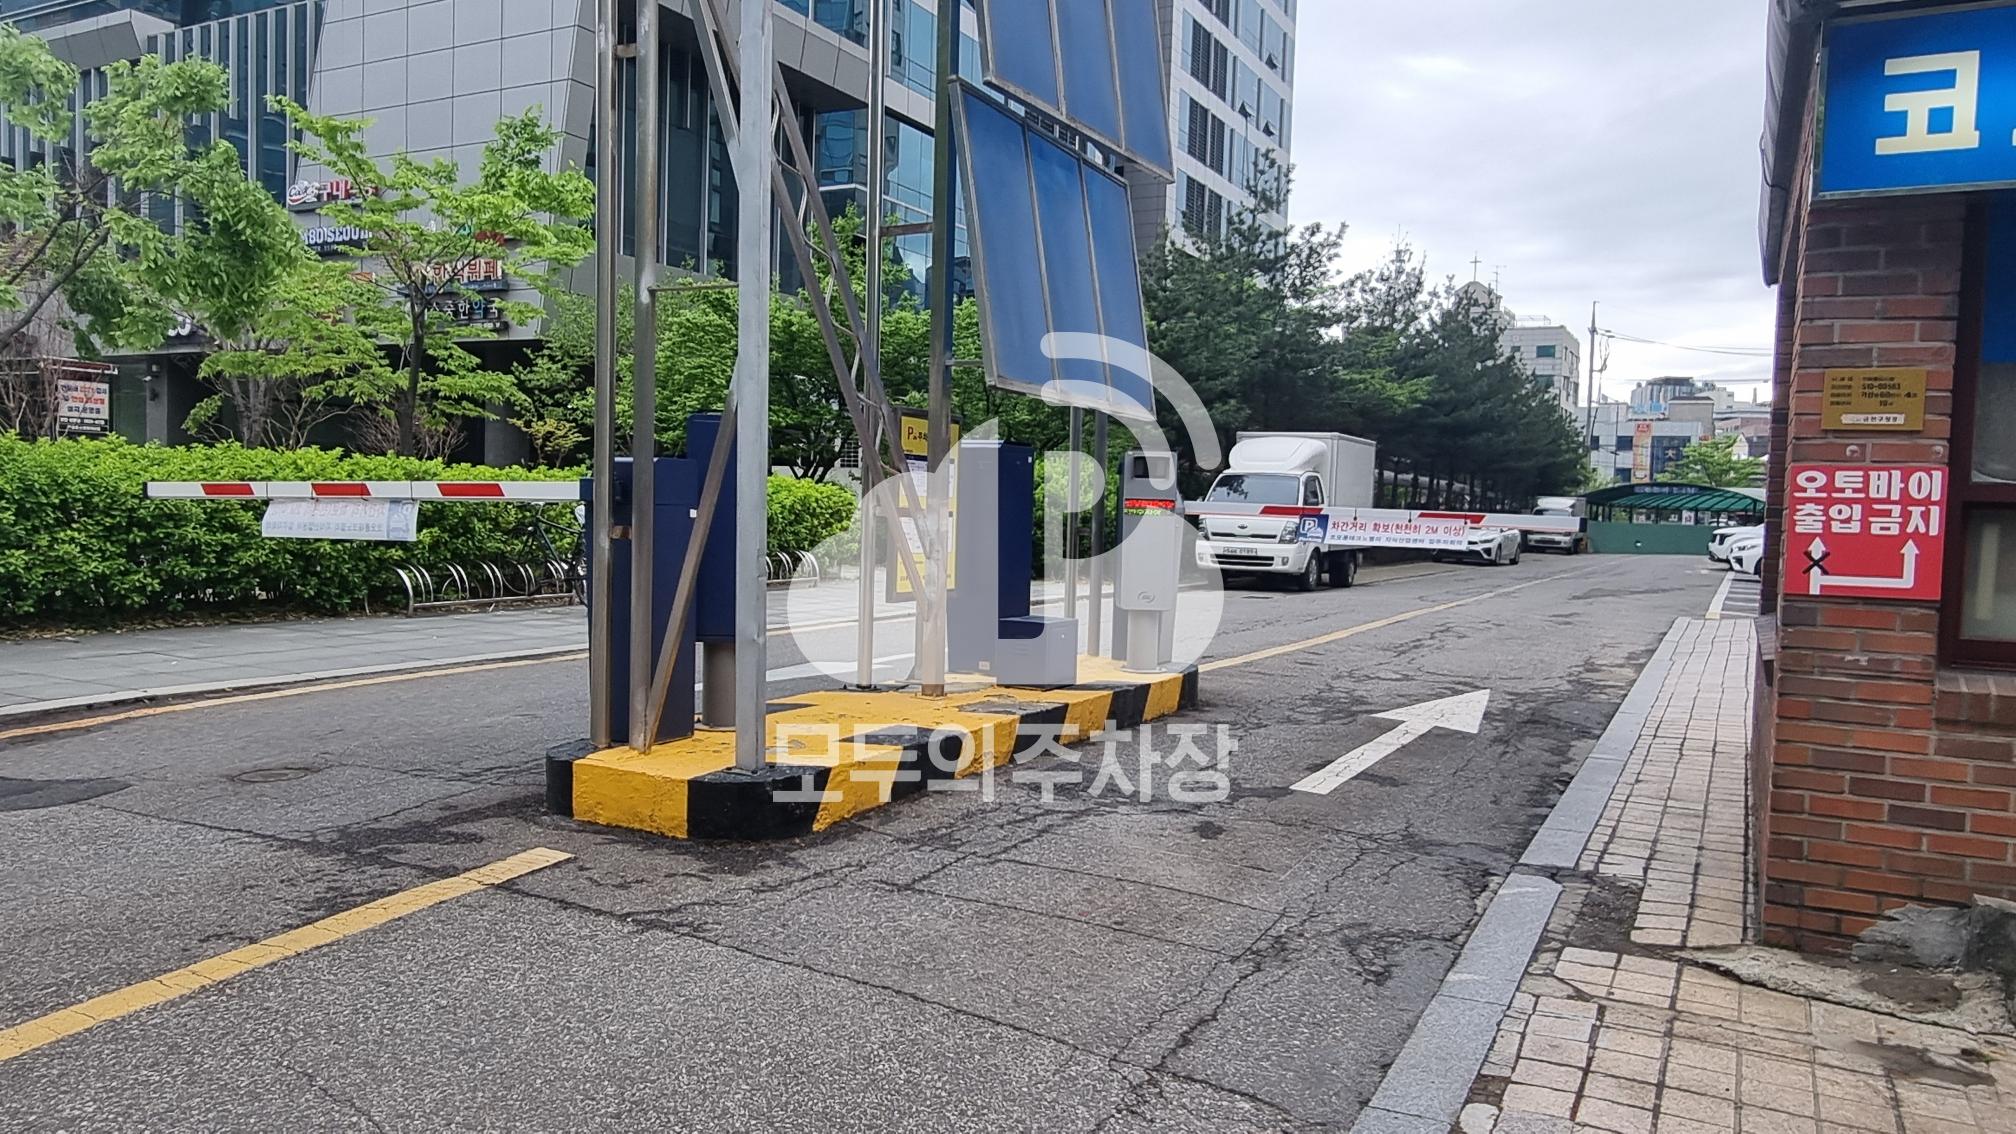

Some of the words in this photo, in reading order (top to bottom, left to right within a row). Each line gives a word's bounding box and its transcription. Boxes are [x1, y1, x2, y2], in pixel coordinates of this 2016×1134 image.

[1875, 50, 2016, 156] 코
[1793, 470, 1942, 501] 오토바이
[1331, 521, 1367, 533] 차간거리
[1425, 525, 1438, 534] 2M
[1443, 526, 1465, 537] 이상)
[1793, 503, 1940, 536] 출입금지
